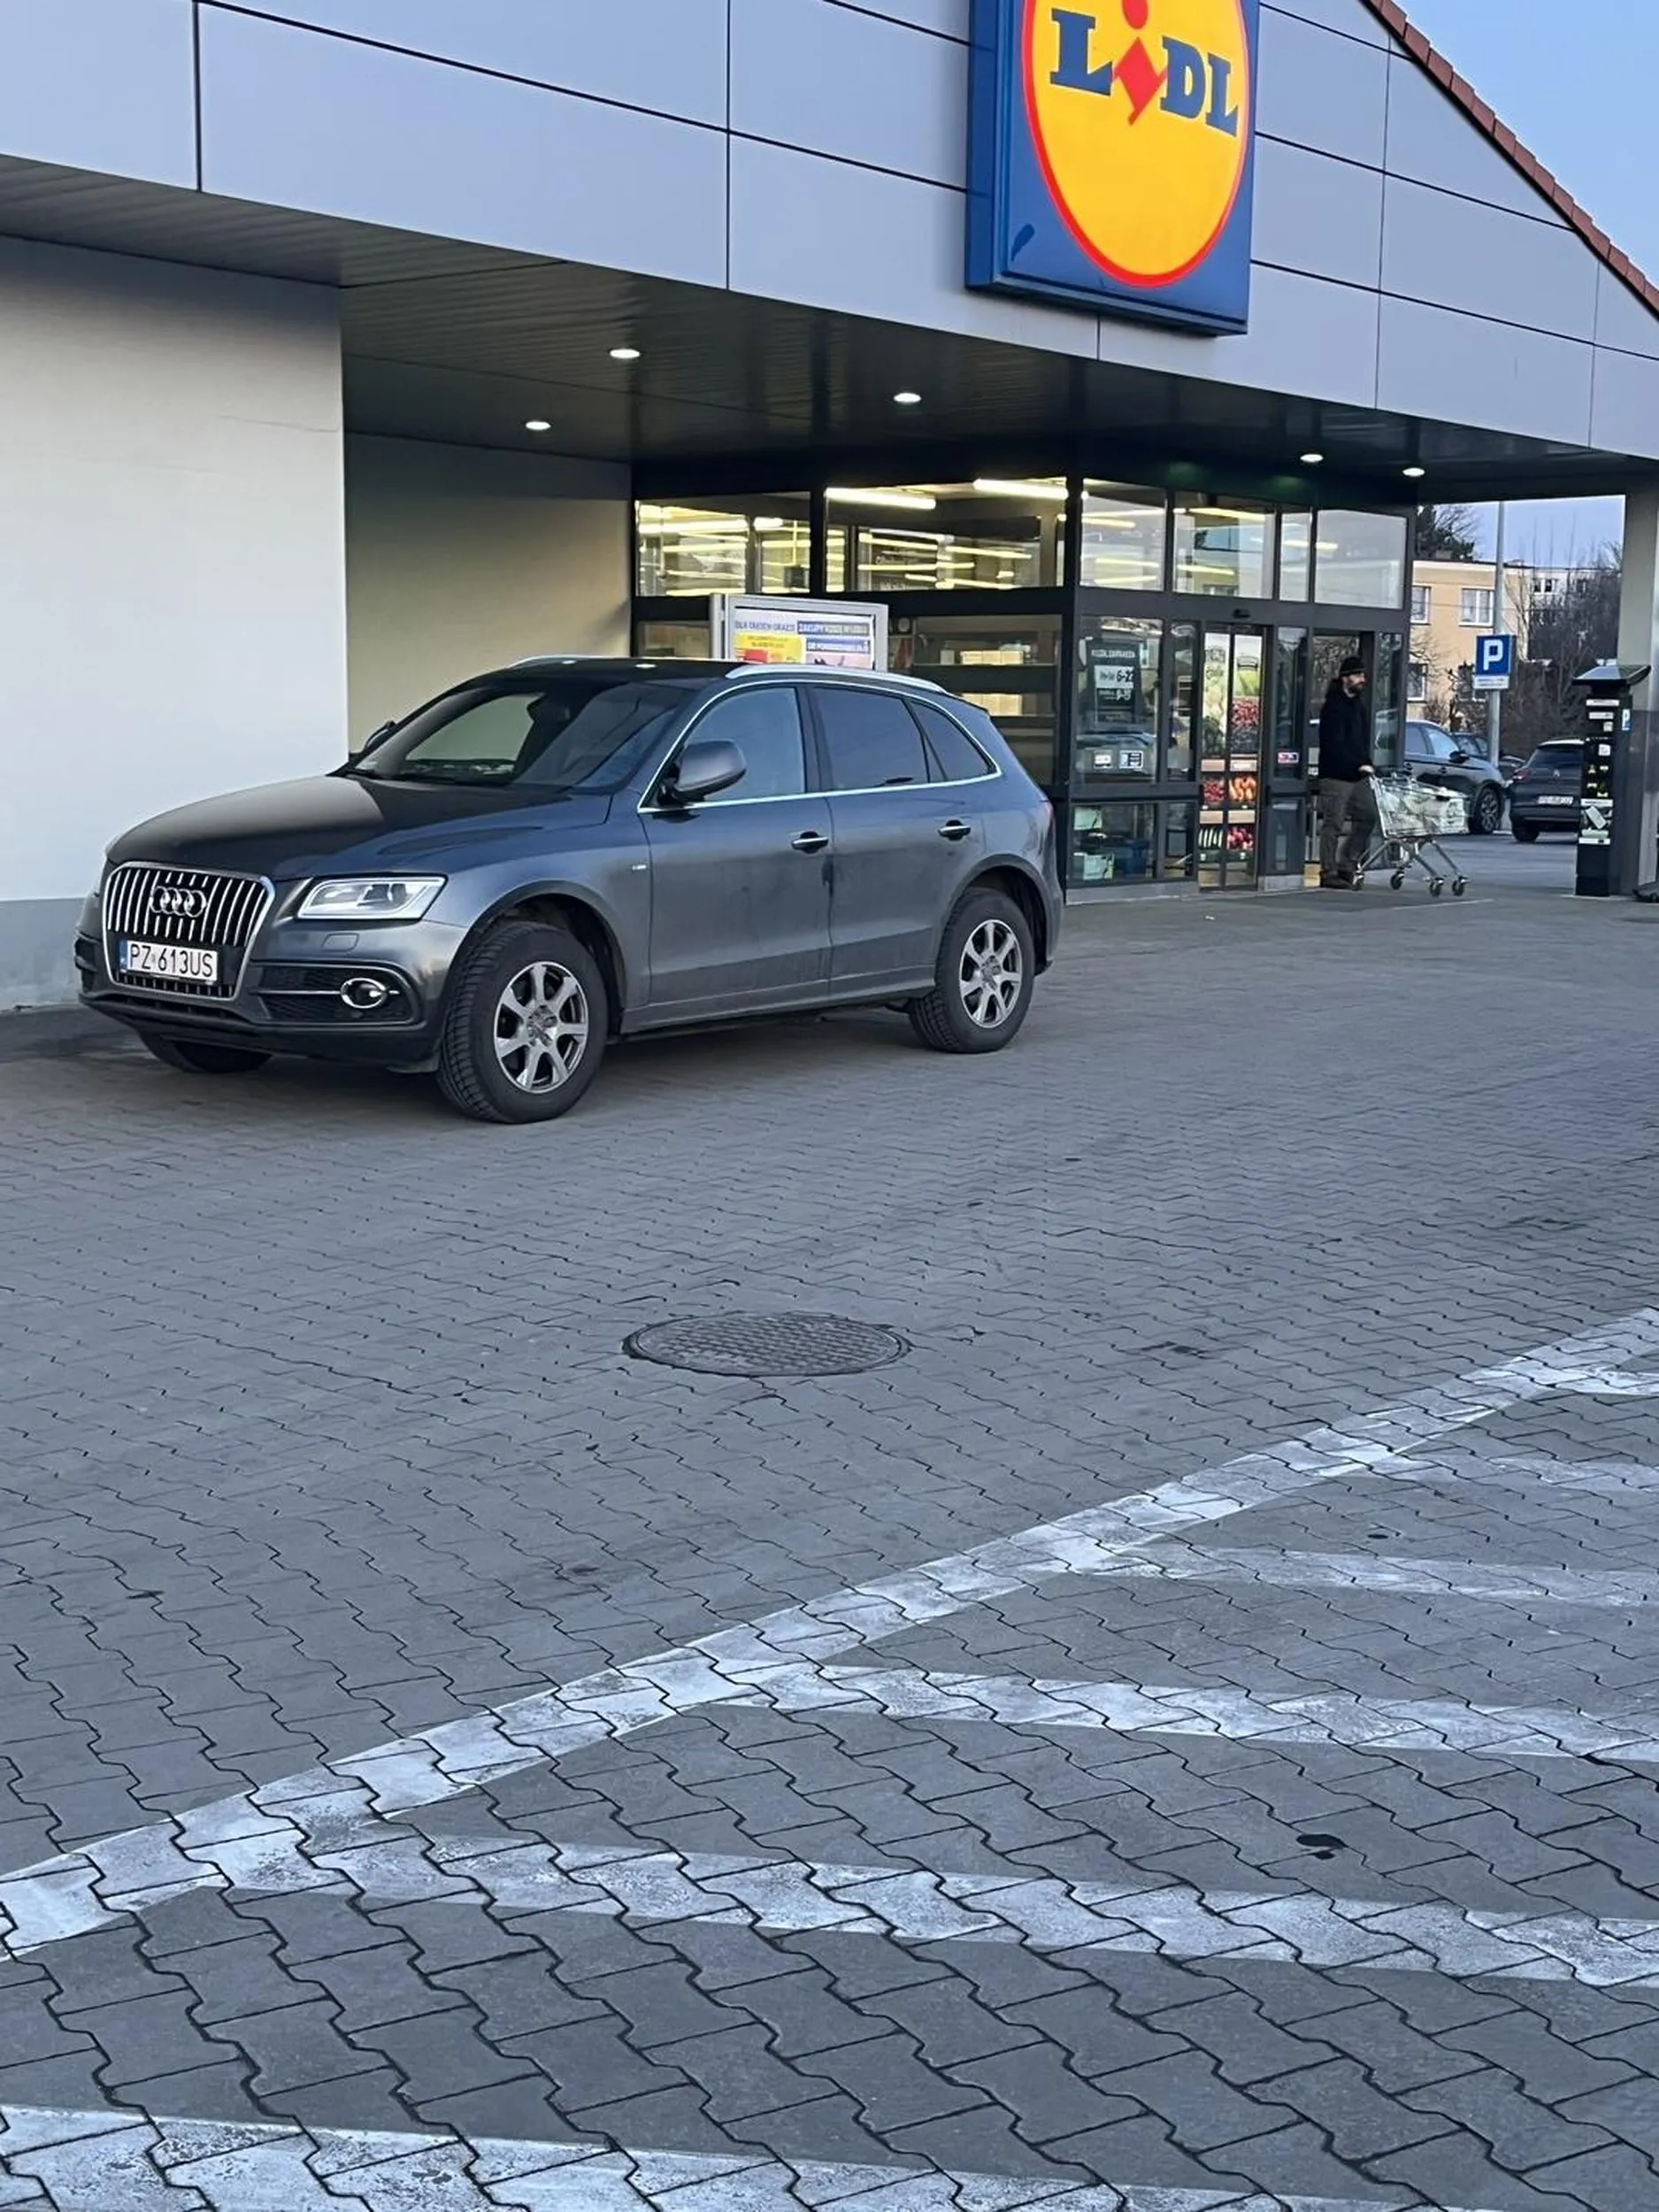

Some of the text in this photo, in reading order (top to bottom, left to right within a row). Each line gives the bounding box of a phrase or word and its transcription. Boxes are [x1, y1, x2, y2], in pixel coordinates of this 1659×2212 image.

[1483, 640, 1503, 670] P
[131, 944, 212, 977] PZ 613US
